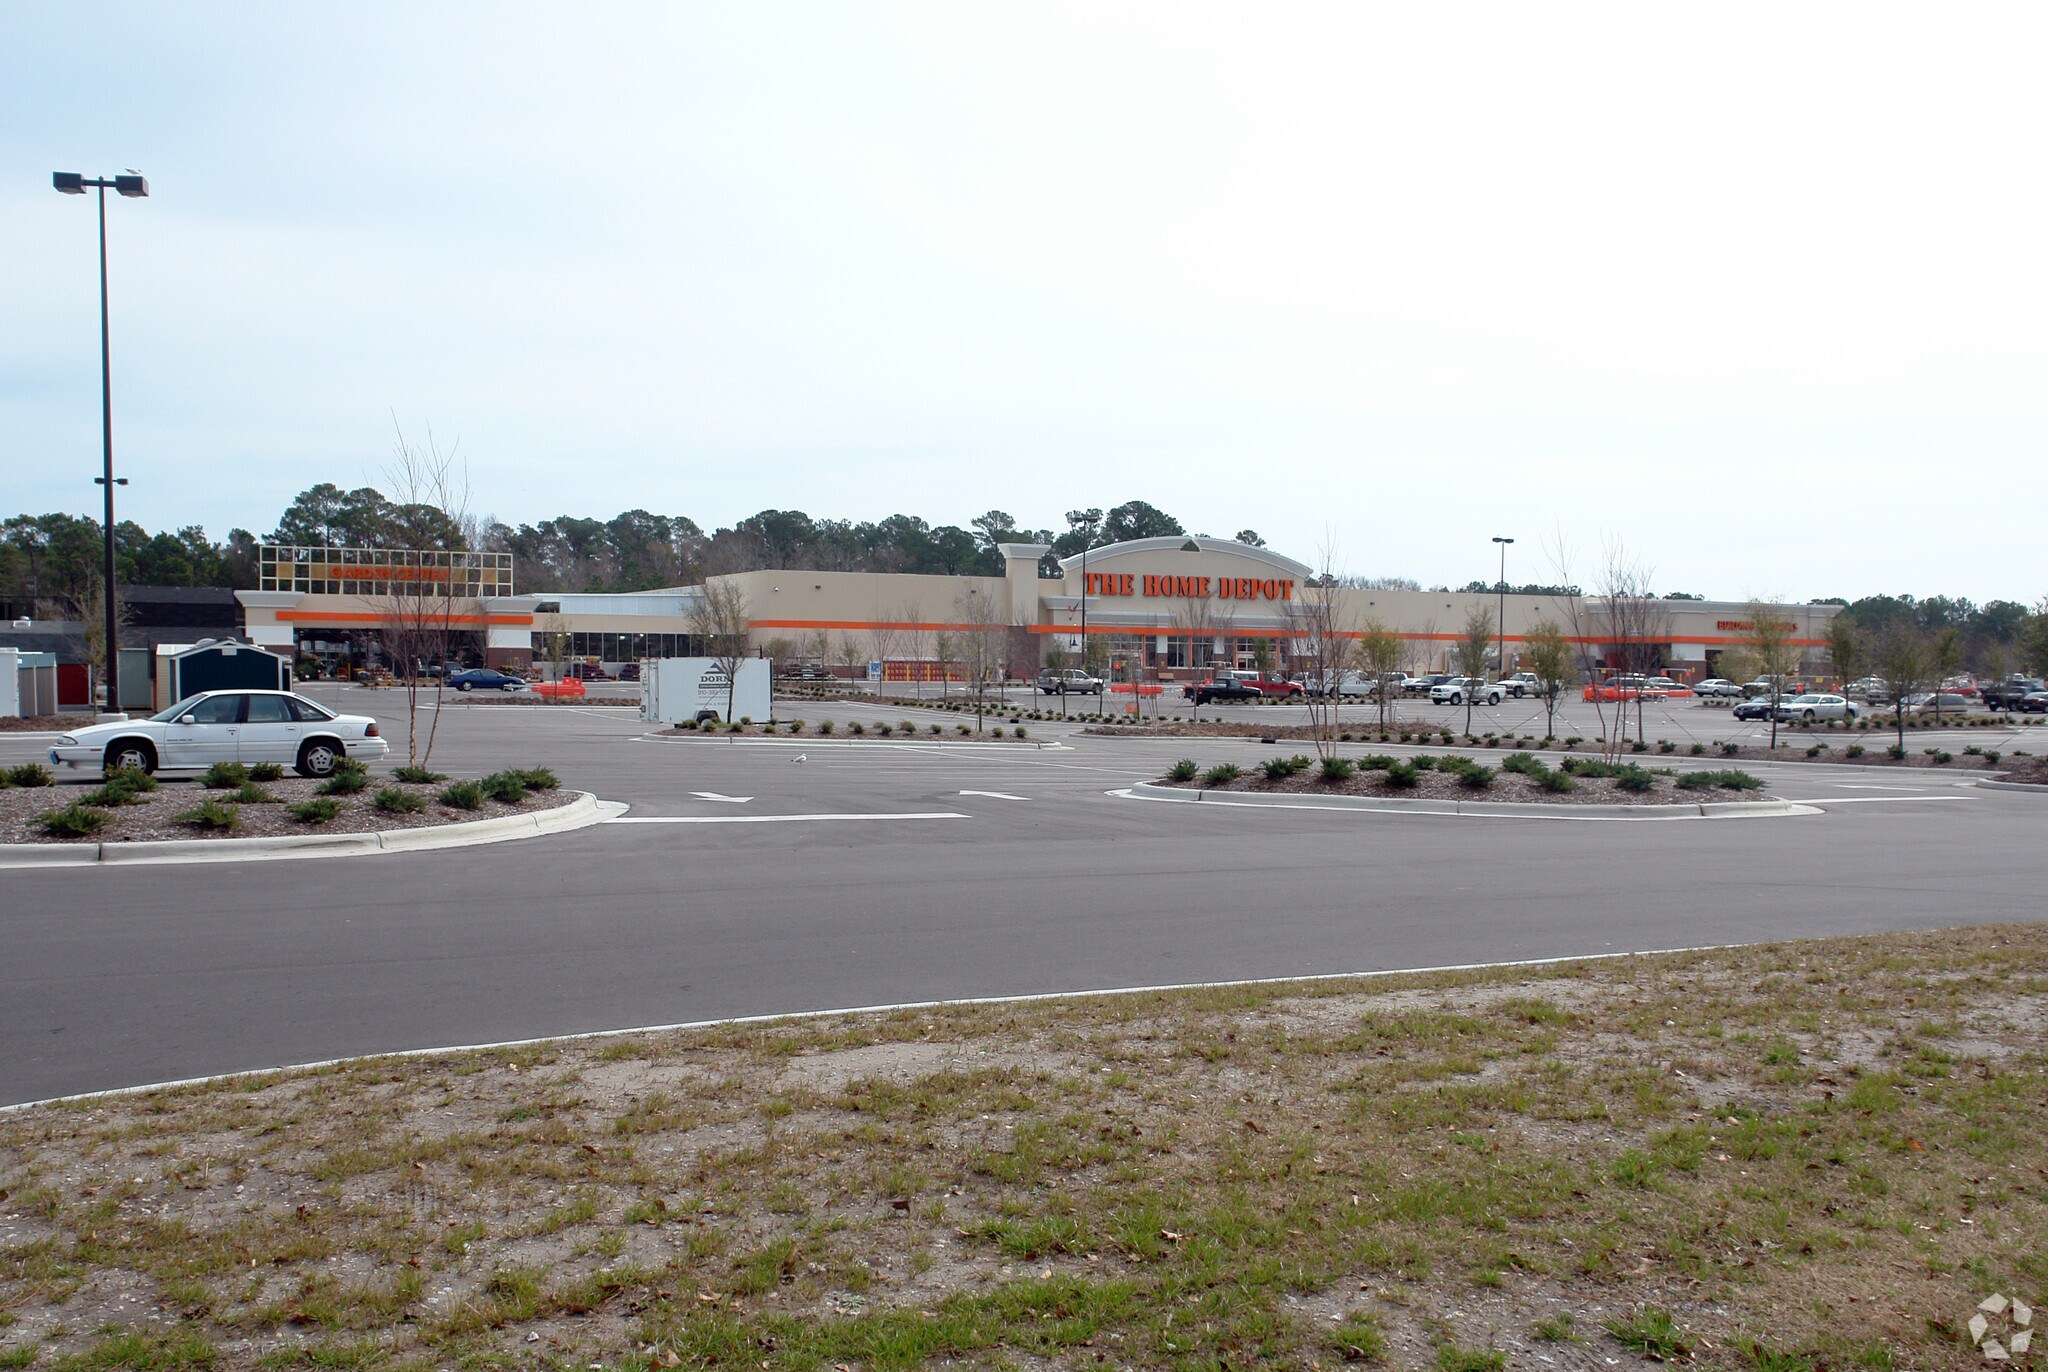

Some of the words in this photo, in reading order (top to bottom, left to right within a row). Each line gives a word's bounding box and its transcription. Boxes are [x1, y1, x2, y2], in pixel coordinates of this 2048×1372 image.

[330, 565, 391, 579] GARDEN
[396, 568, 448, 580] CENTER
[1084, 572, 1135, 596] THE
[1142, 574, 1212, 599] HOME
[1218, 577, 1295, 601] DEPOT
